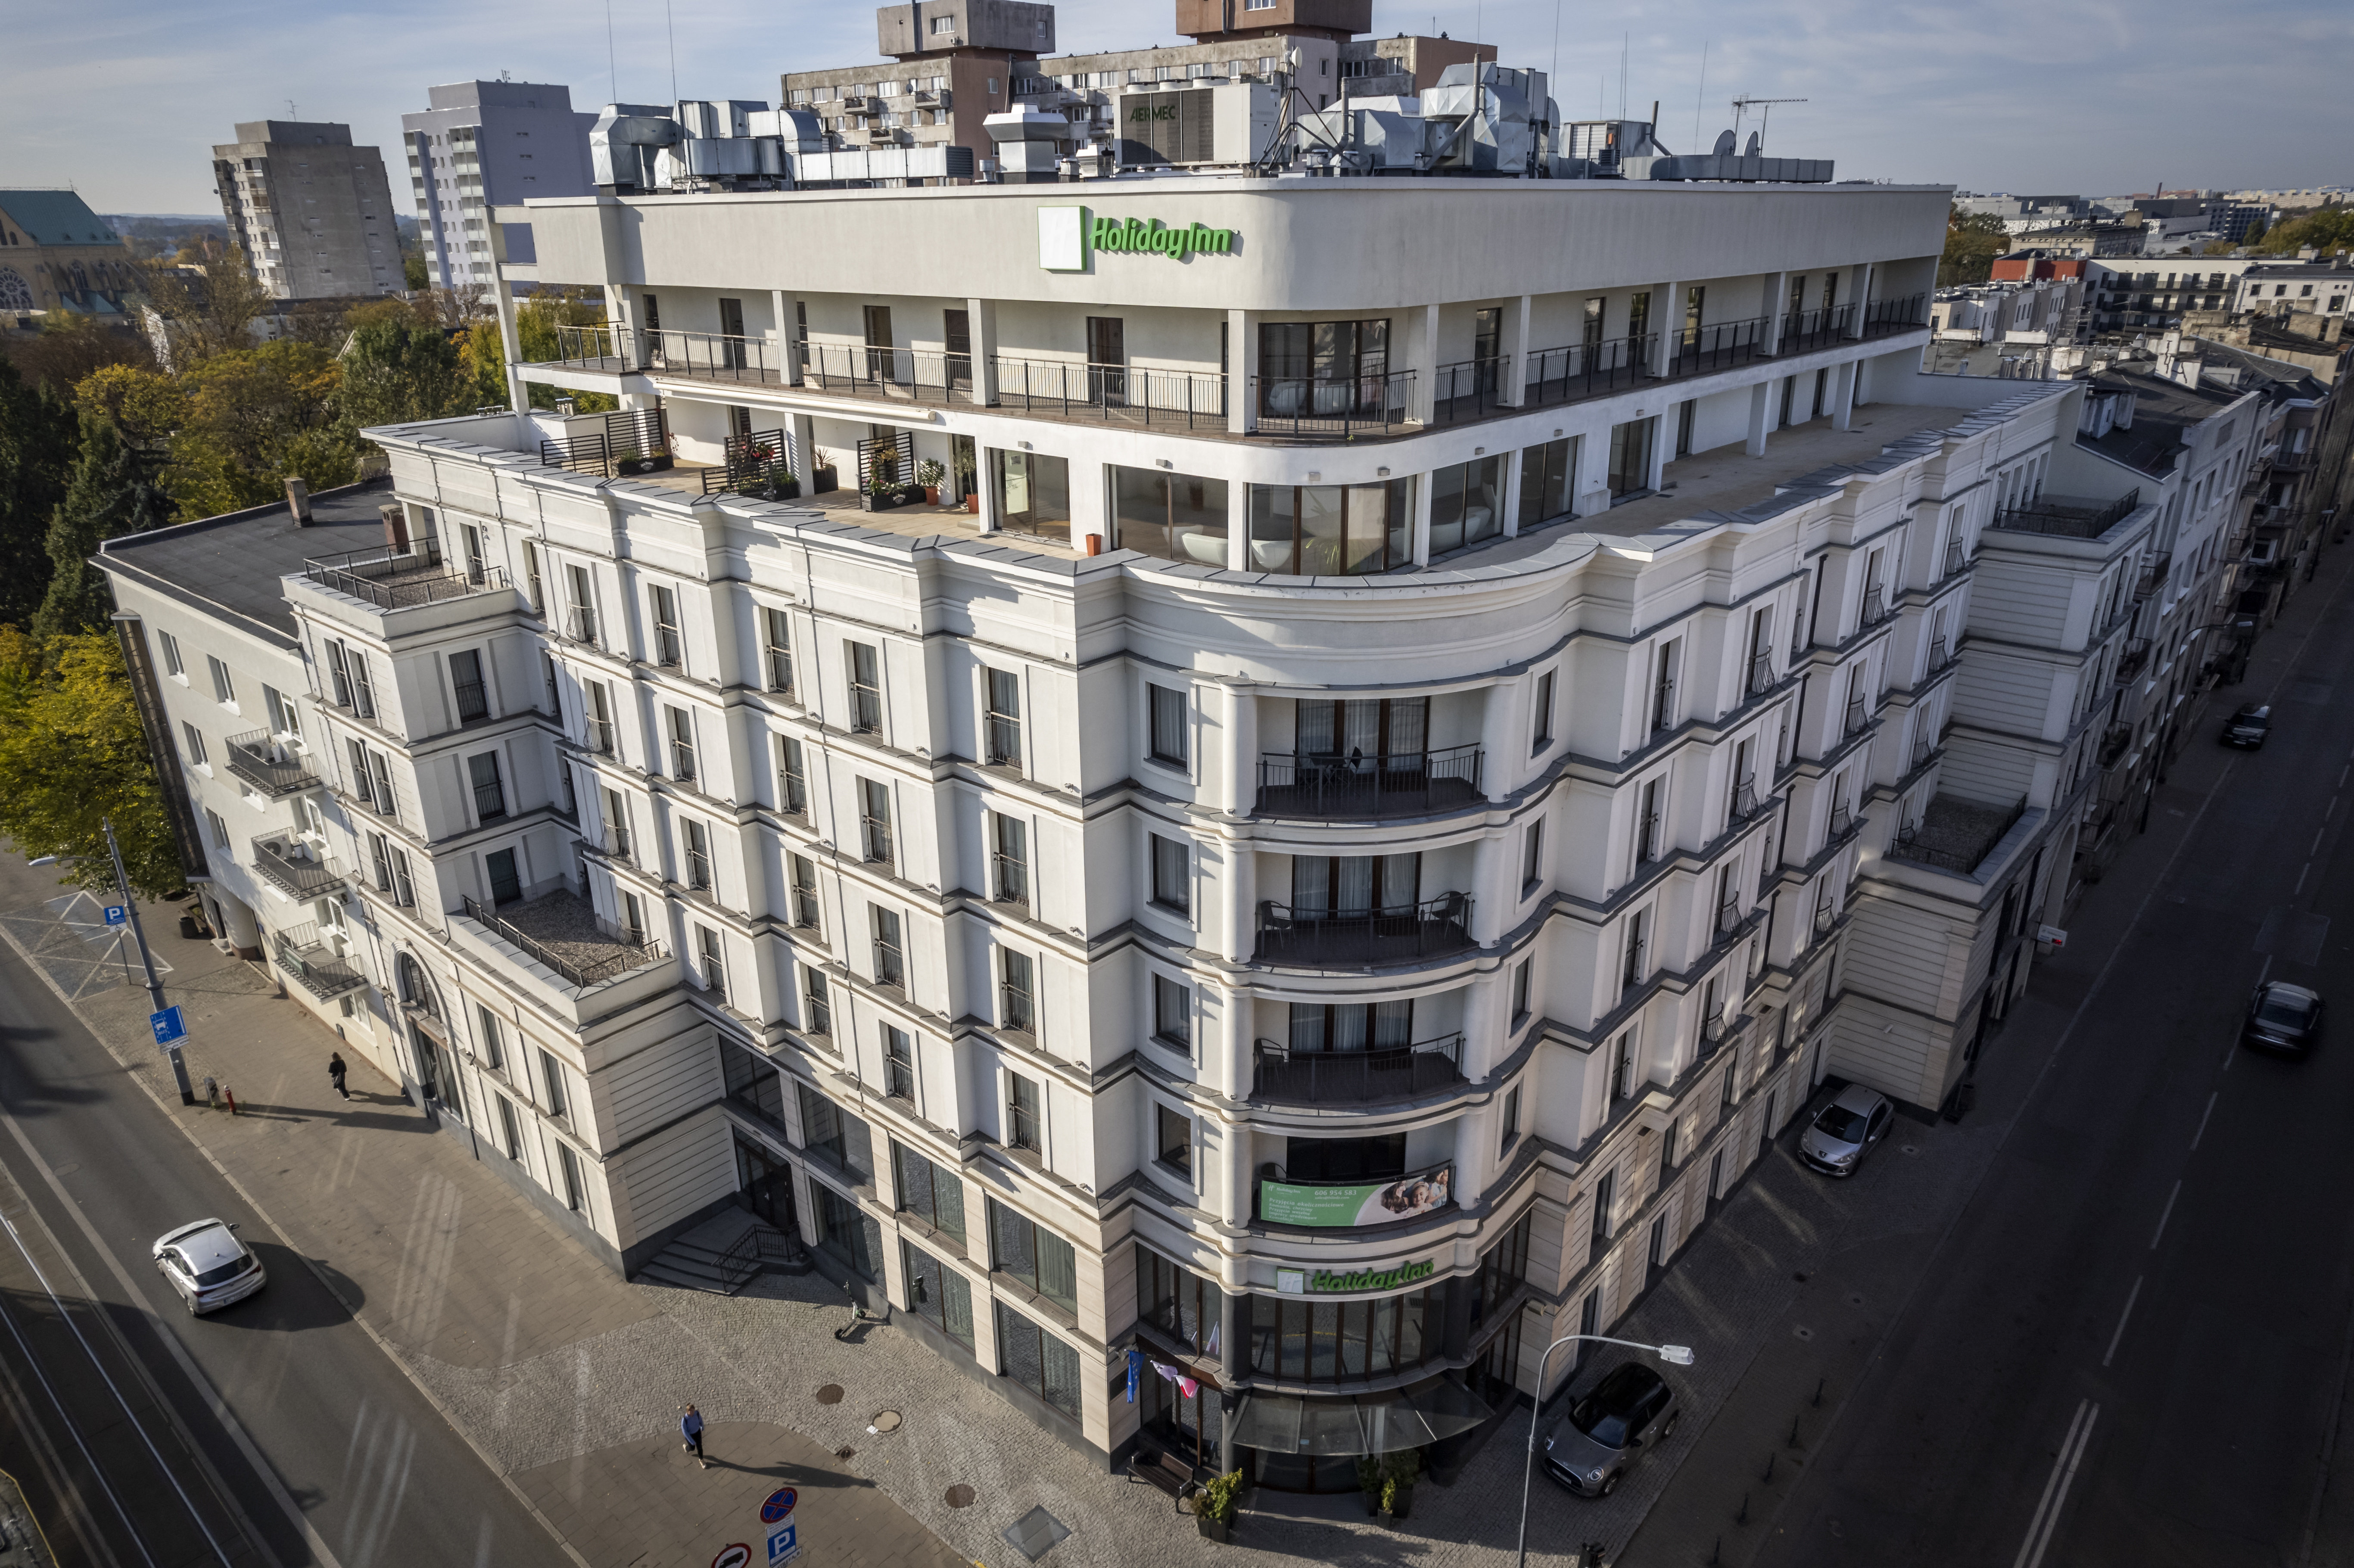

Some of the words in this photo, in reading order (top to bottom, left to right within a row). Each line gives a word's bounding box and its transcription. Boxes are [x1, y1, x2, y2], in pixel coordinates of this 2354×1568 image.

[1130, 106, 1175, 122] AERMEC
[1089, 217, 1188, 259] Holiday
[1187, 222, 1233, 252] Inn
[108, 908, 120, 920] P
[1311, 1267, 1400, 1291] Holiday
[1401, 1260, 1434, 1282] Inn
[774, 1531, 790, 1555] P
